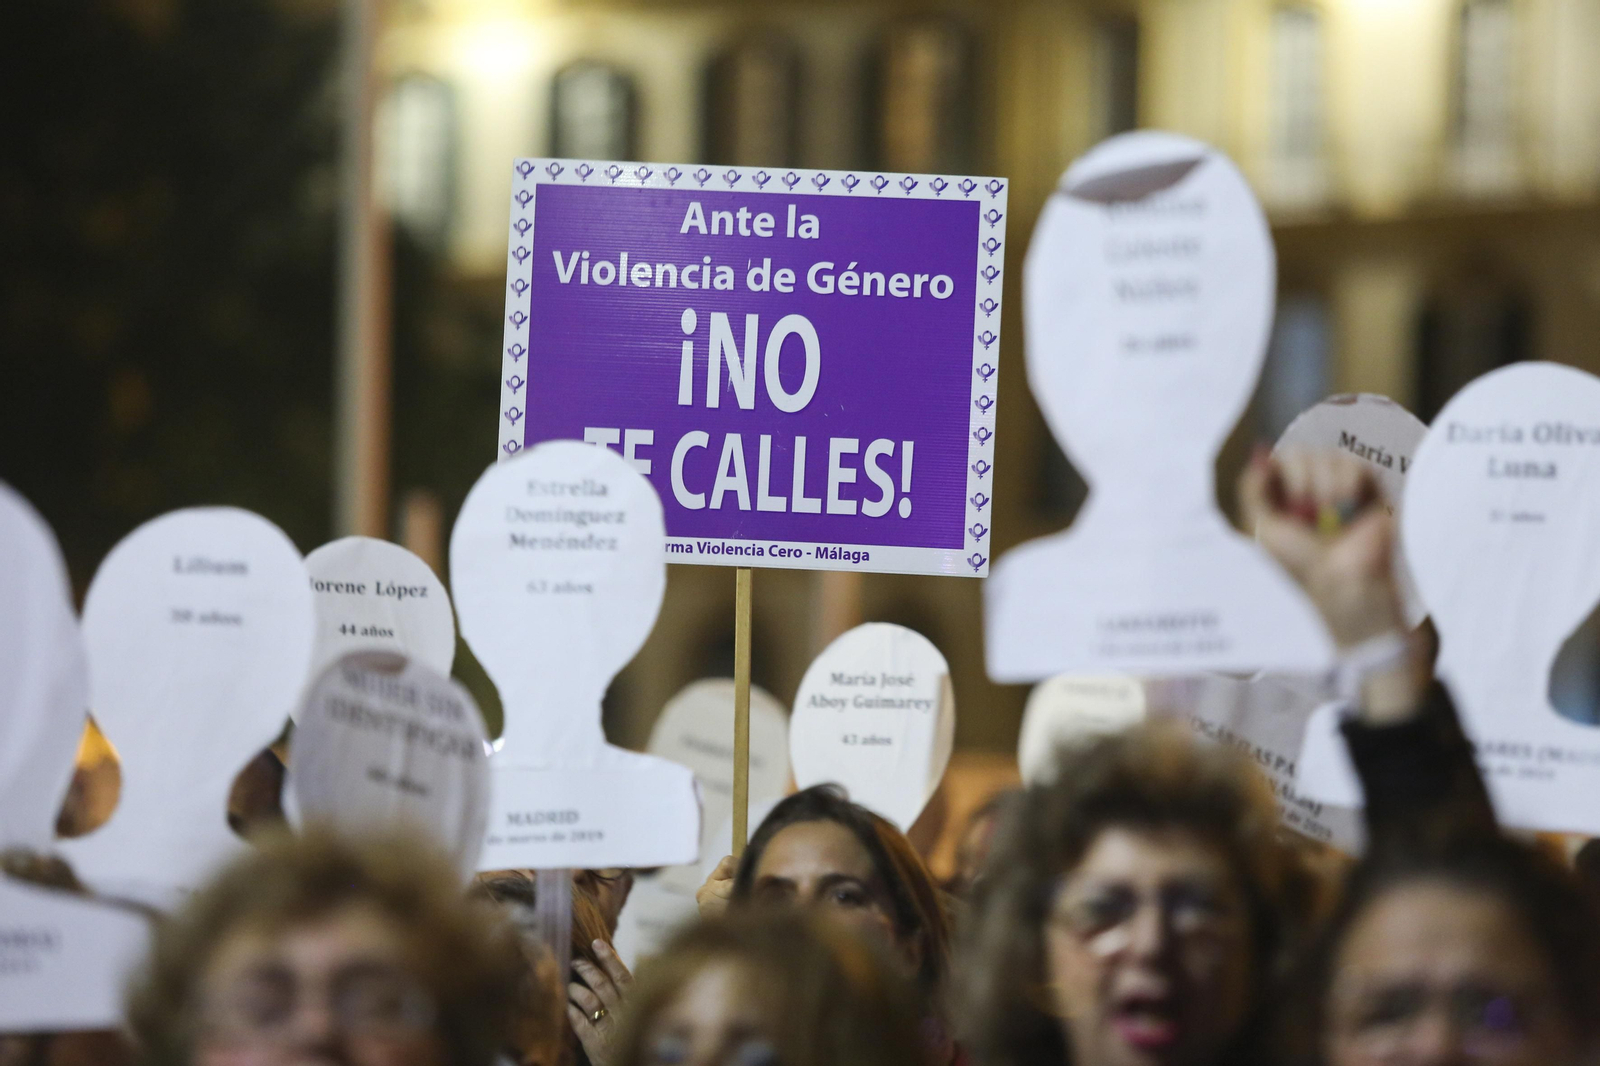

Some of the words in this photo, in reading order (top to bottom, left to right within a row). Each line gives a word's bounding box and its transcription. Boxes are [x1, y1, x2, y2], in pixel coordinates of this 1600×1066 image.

[680, 202, 775, 237] Ante
[786, 204, 820, 239] la
[552, 250, 735, 290] Violencia
[746, 258, 796, 293] de
[806, 261, 955, 300] Género
[678, 307, 822, 414] ¡NO
[1339, 430, 1393, 469] María
[670, 430, 914, 519] CALLES!
[697, 541, 765, 557] Violencia
[768, 544, 802, 558] Cero
[815, 546, 870, 564] Málaga
[375, 581, 428, 600] López
[338, 624, 356, 636] 44
[361, 625, 394, 638] años
[830, 672, 876, 687] María
